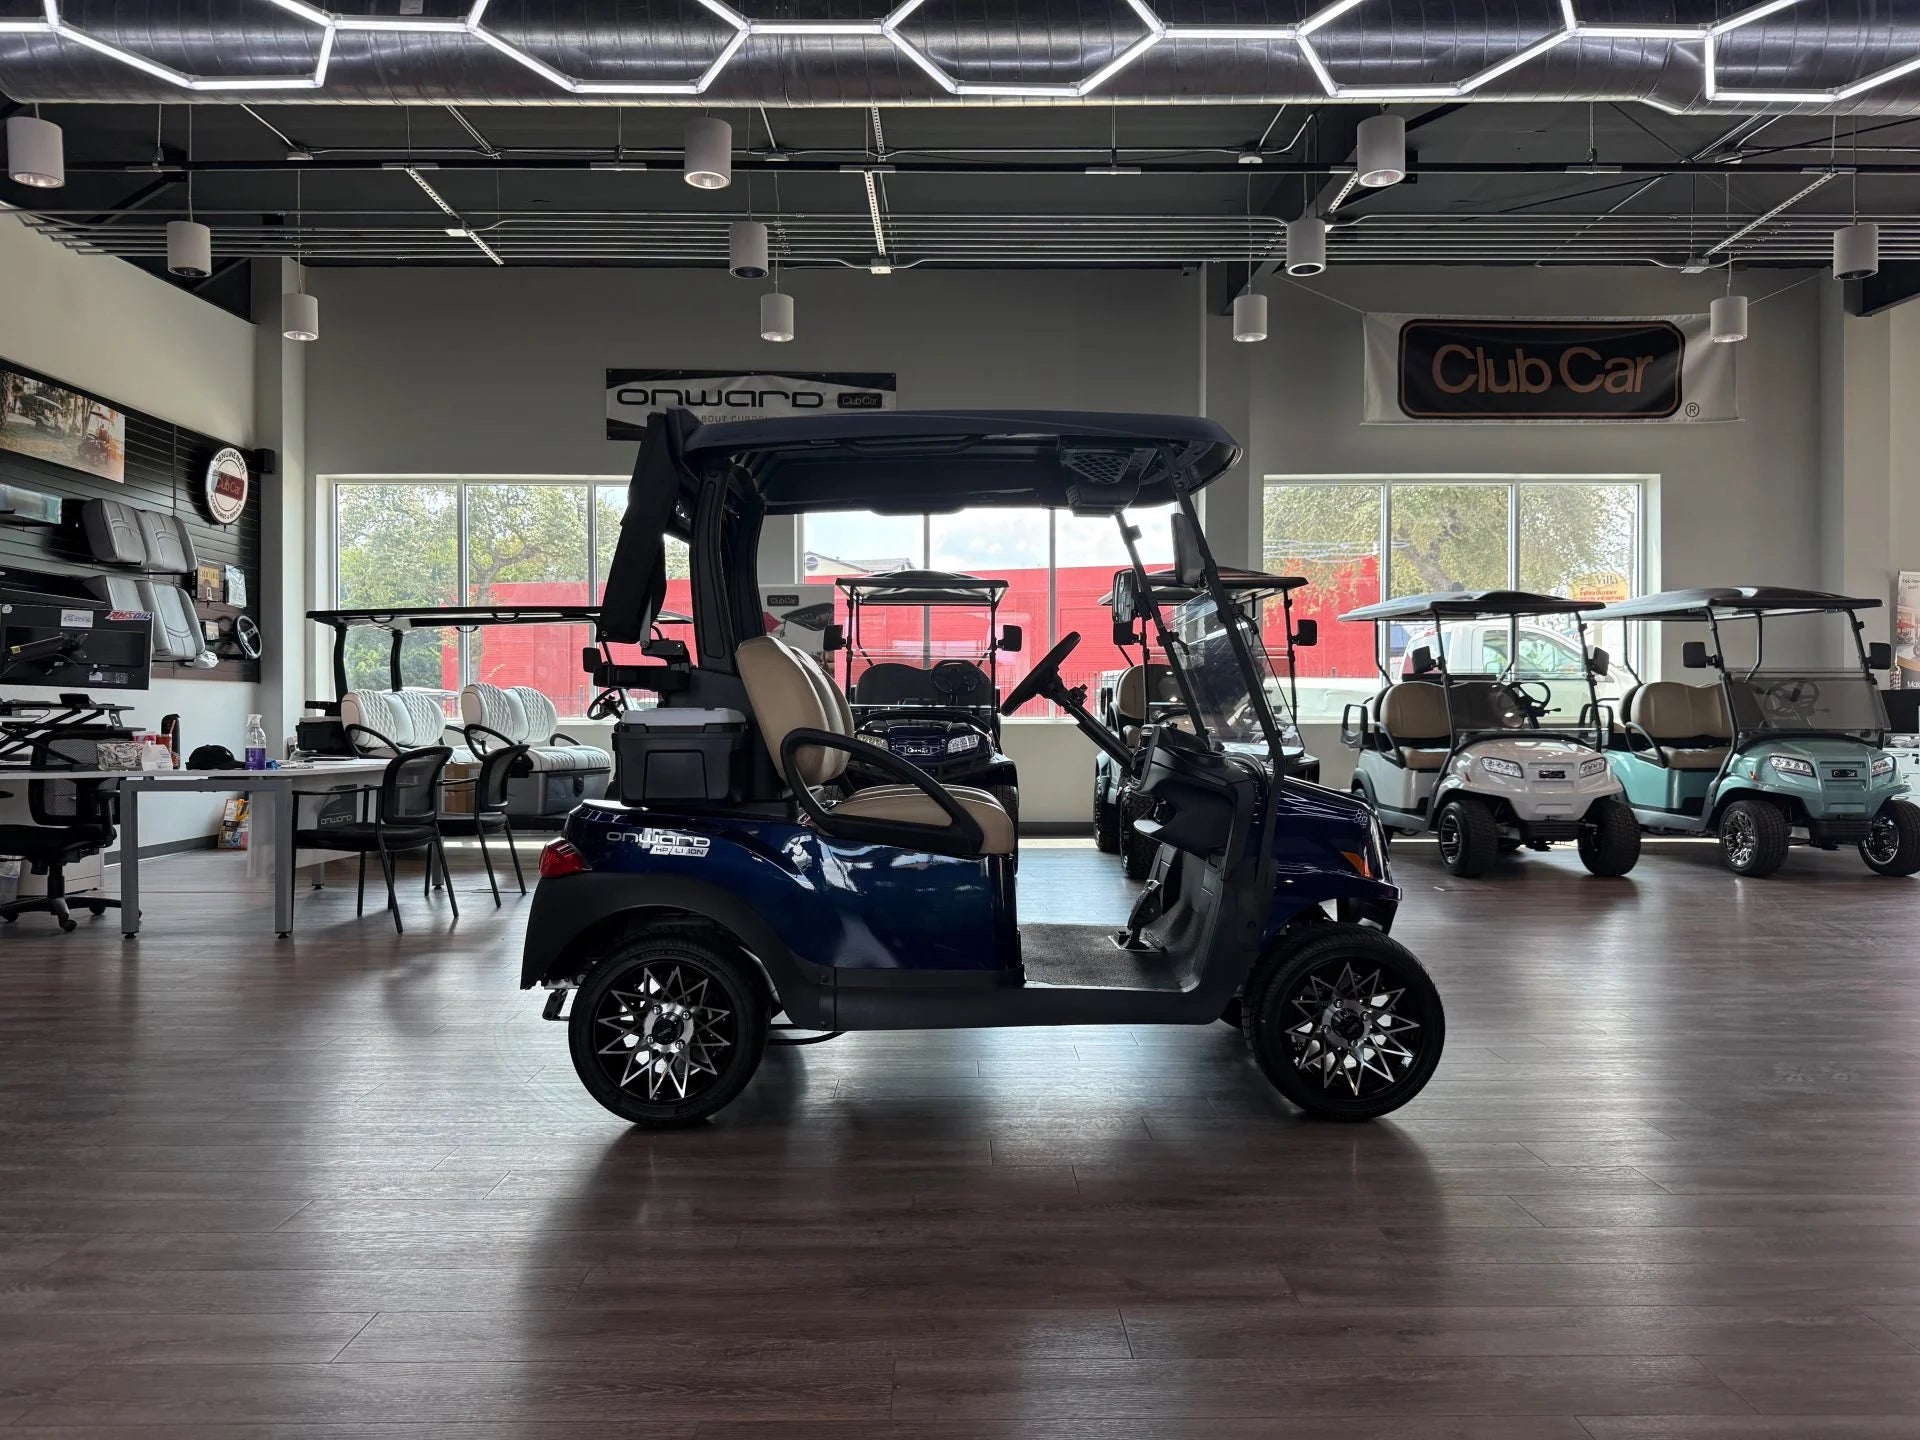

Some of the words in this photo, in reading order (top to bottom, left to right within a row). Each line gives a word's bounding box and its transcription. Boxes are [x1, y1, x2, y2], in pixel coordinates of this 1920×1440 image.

[1432, 344, 1552, 393] Club
[1559, 347, 1654, 393] Car
[842, 396, 861, 405] Club
[862, 396, 878, 405] Car
[1596, 575, 1618, 584] Villa
[109, 611, 151, 620] AMSOIL
